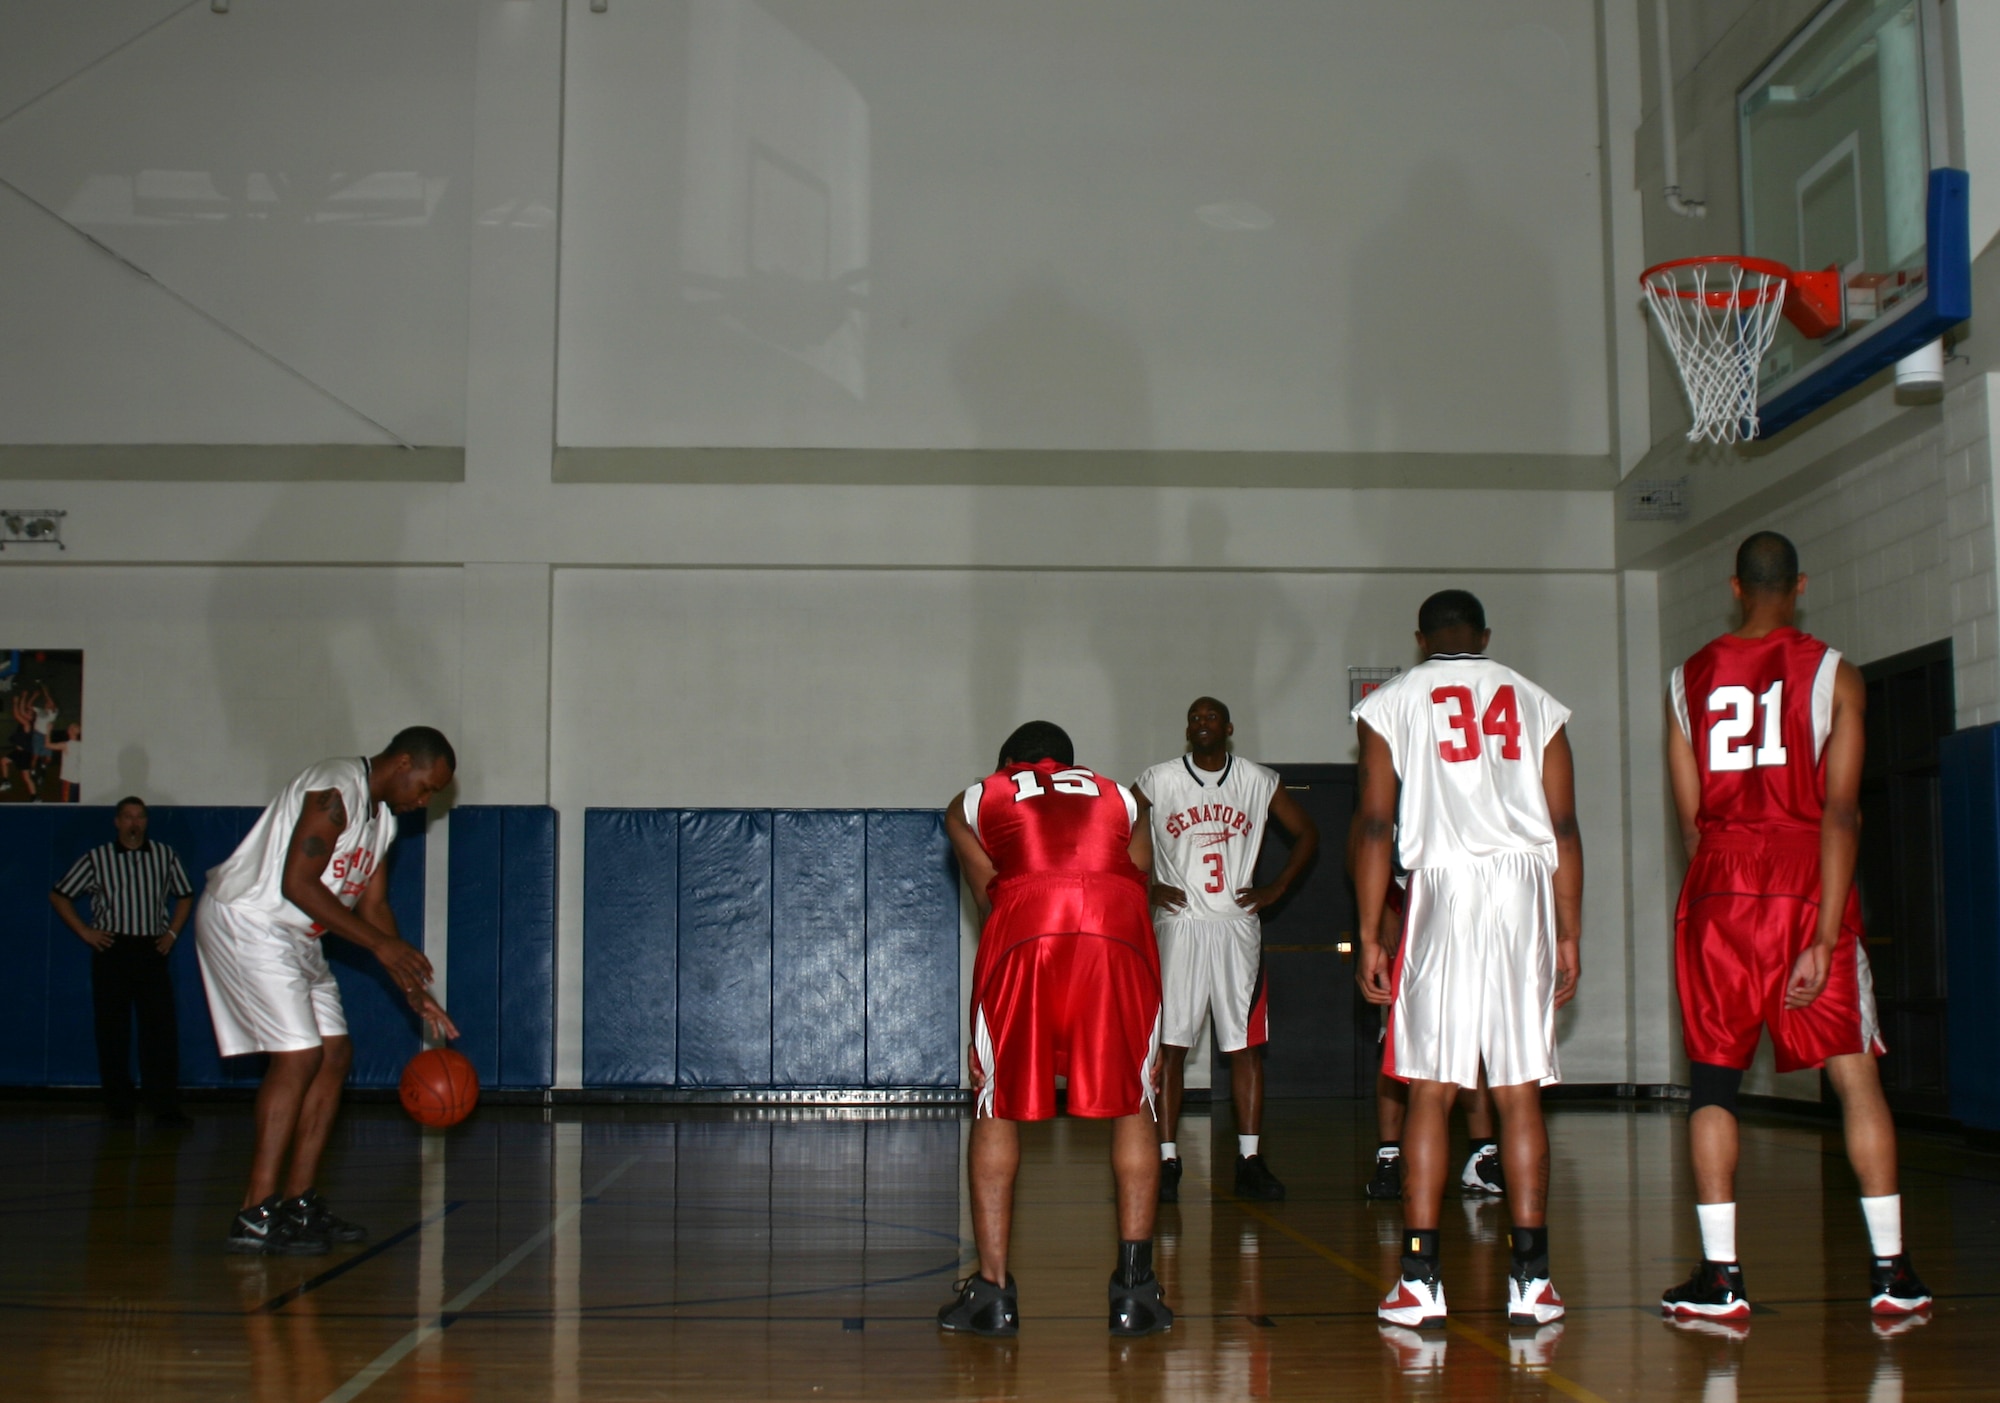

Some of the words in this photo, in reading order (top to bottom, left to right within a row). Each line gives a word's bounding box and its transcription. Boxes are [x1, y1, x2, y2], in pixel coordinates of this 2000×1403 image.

[1431, 685, 1521, 763] 34
[1707, 680, 1788, 772] 21
[1010, 768, 1101, 803] 15
[1166, 804, 1253, 839] SENATORS
[1202, 853, 1225, 893] 3
